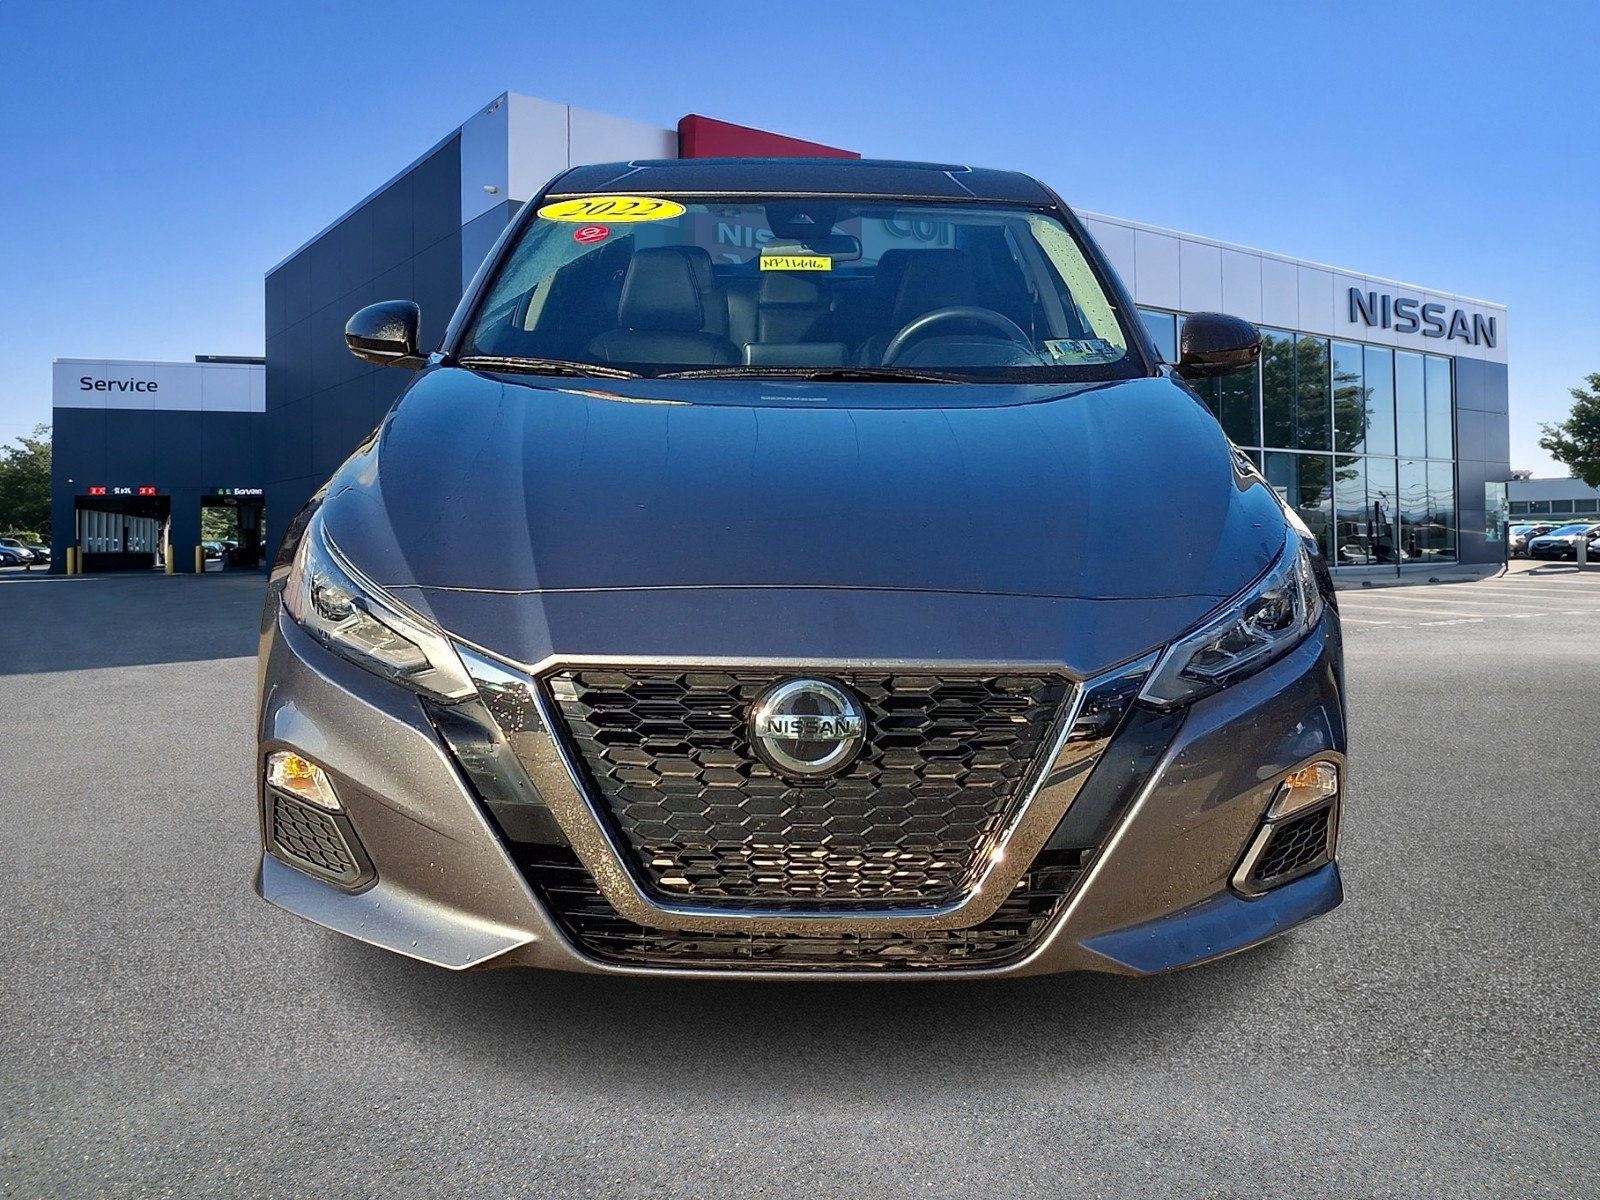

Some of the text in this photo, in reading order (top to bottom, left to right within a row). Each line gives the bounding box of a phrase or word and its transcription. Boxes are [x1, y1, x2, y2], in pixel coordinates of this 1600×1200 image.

[559, 202, 663, 217] 2022
[1349, 287, 1498, 348] NISSAN
[80, 376, 158, 393] Service
[767, 720, 850, 734] NISSAN
